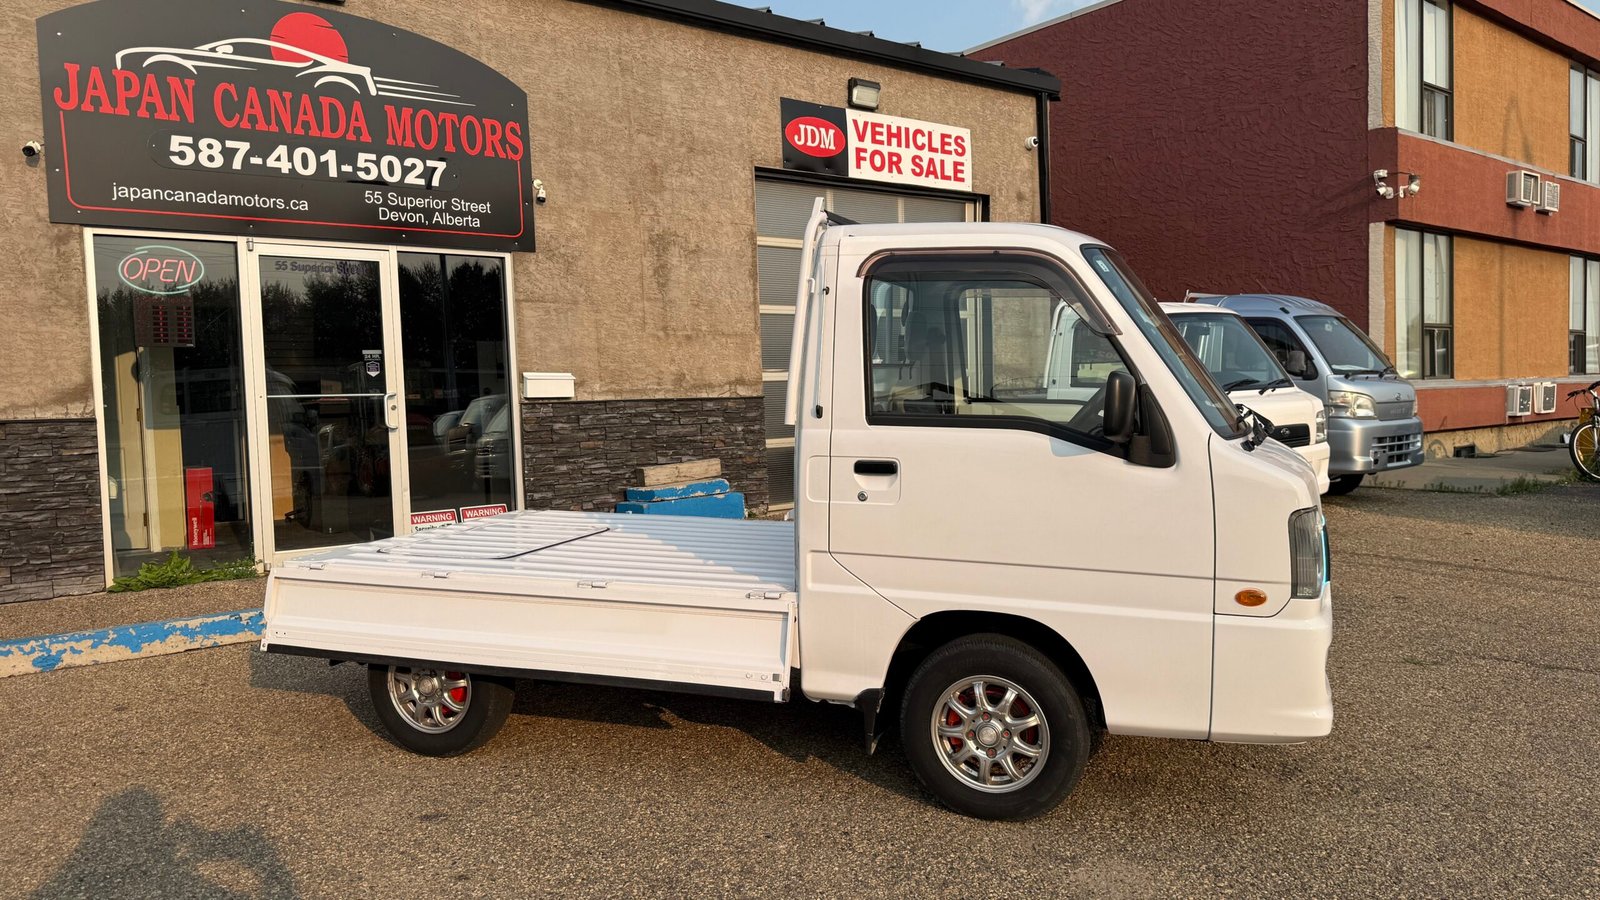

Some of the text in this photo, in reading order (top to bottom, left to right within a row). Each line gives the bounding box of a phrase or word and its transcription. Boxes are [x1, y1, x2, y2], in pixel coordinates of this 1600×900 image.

[53, 62, 524, 161] JAPAN CANADA MOTORS
[794, 123, 836, 150] JDM
[852, 118, 966, 157] VEHICLES
[168, 134, 447, 188] 587-401-5027
[855, 147, 965, 183] FOR SALE
[112, 182, 309, 211] japancanadamotors.ca
[364, 190, 491, 213] 55 Superior Street
[378, 207, 481, 228] Devon, Alberta
[123, 257, 196, 283] OPEN
[274, 260, 288, 271] 55
[290, 261, 335, 275] Superior
[412, 513, 452, 523] WARNING
[465, 507, 504, 518] WARNING
